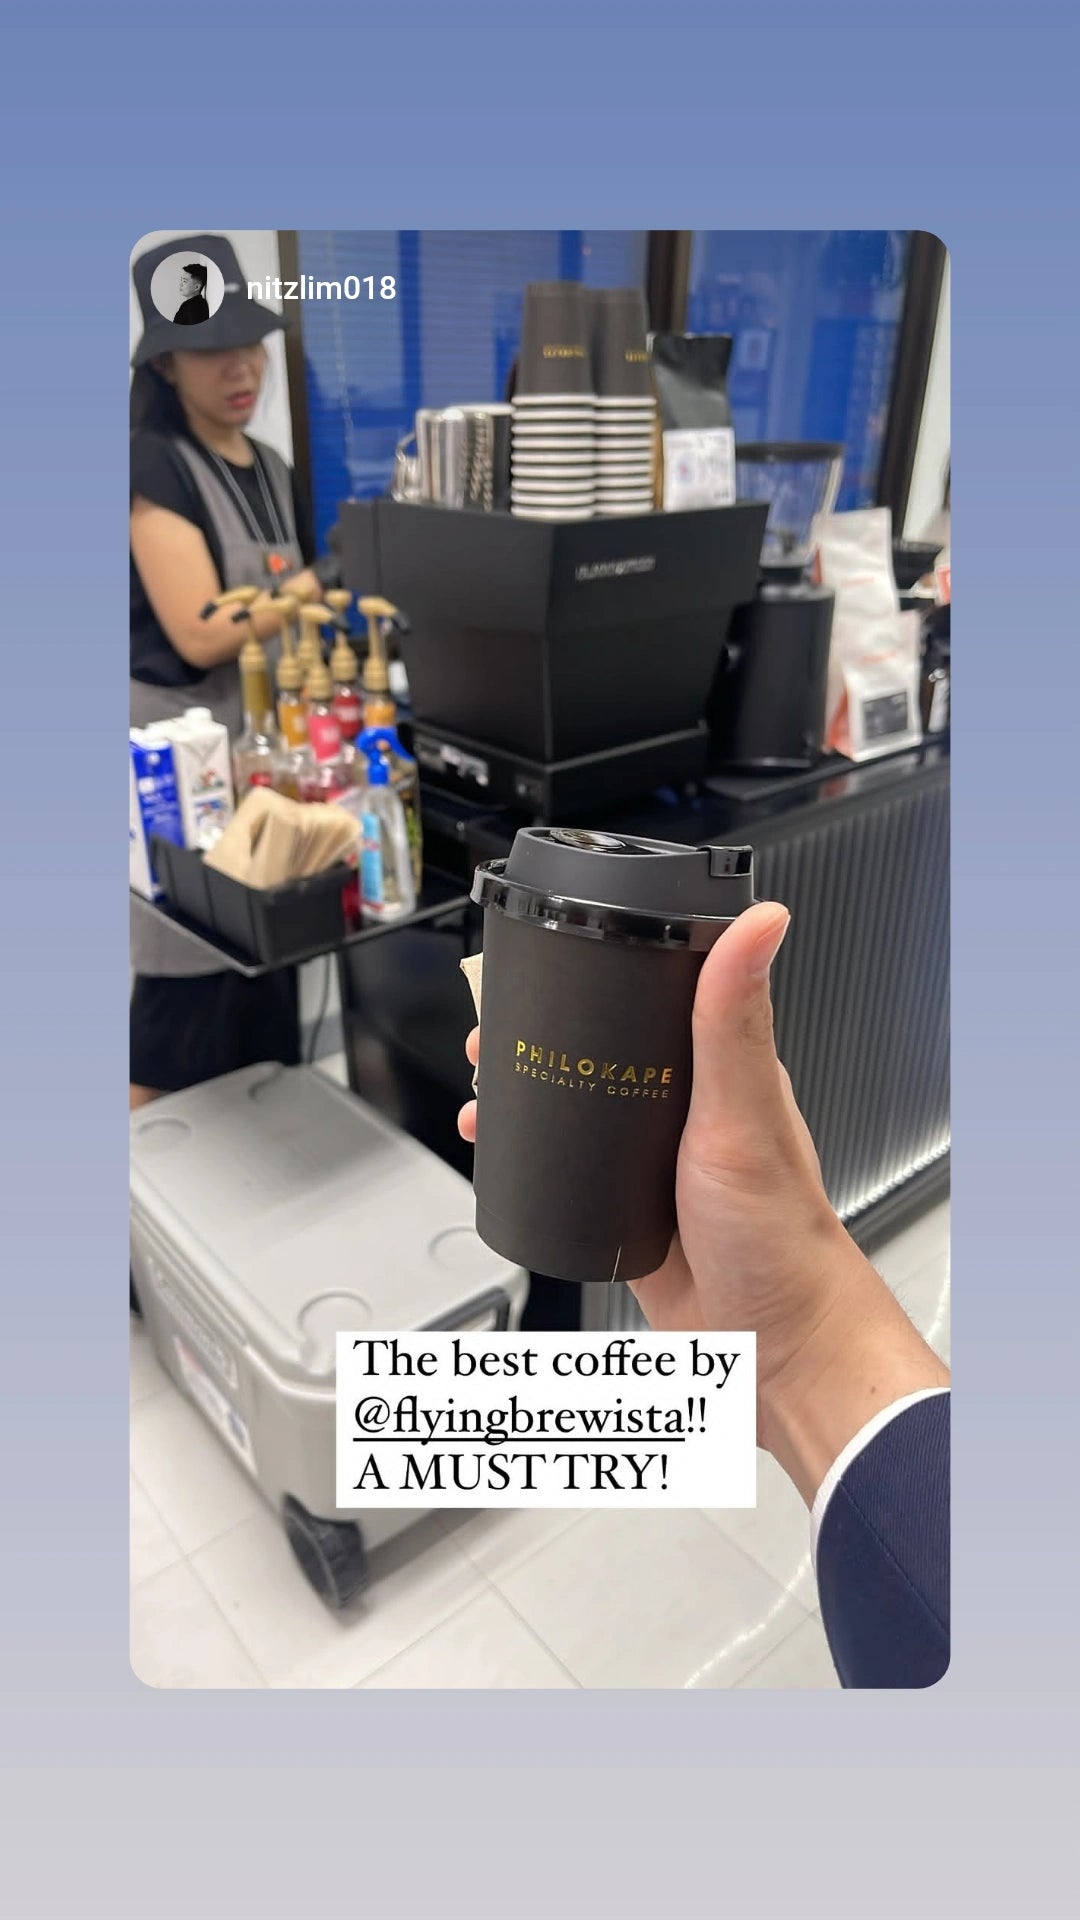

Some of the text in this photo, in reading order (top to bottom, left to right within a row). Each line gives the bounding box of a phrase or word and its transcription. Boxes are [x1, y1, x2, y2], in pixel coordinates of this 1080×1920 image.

[514, 1062, 669, 1099] SPECIALTY COFFEE
[515, 1039, 674, 1085] PHILOKAPE
